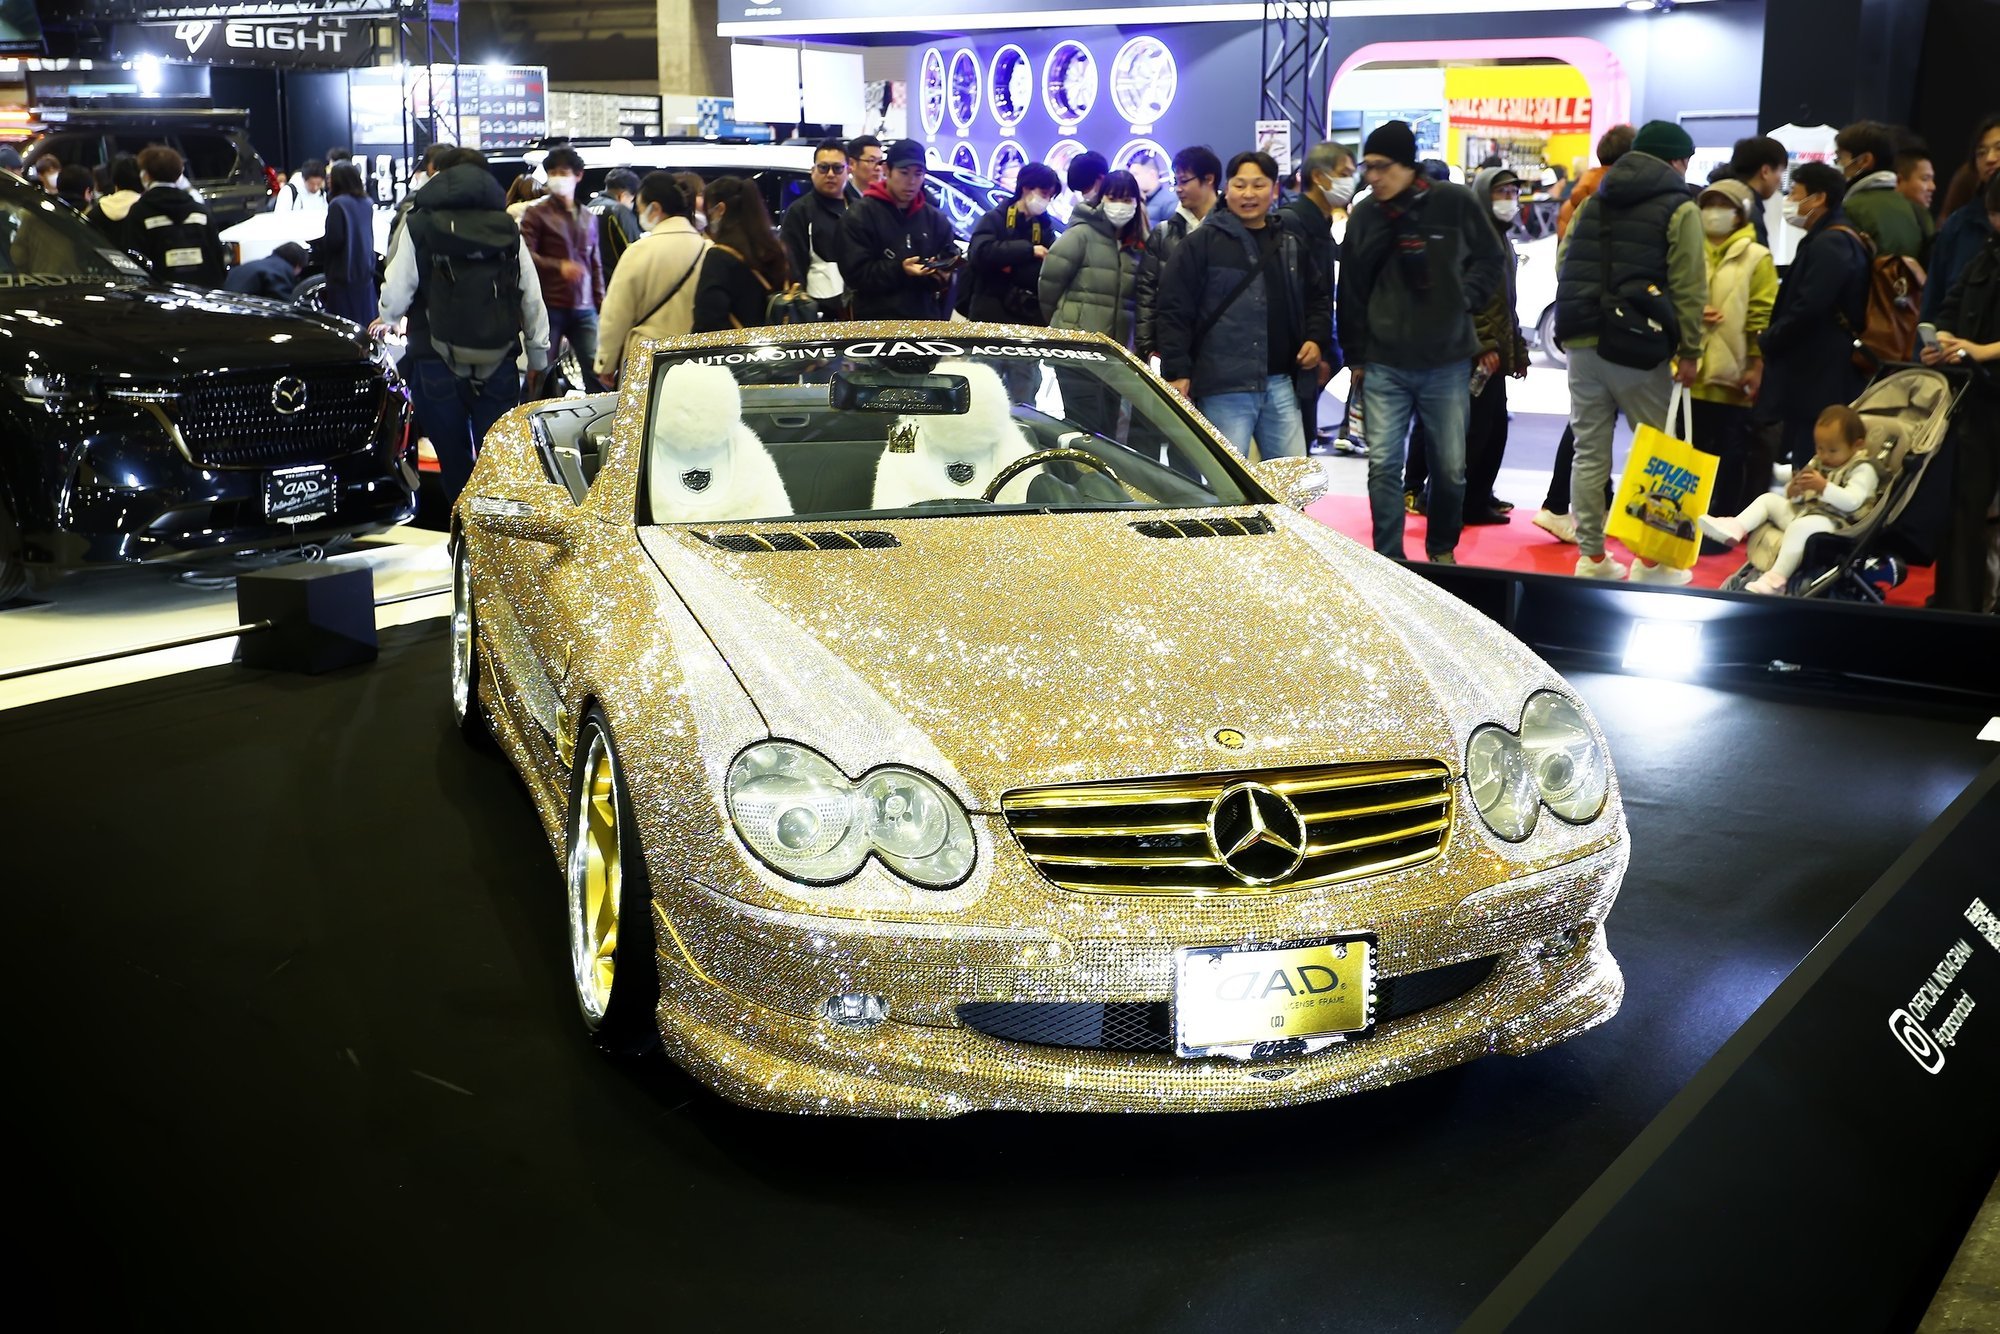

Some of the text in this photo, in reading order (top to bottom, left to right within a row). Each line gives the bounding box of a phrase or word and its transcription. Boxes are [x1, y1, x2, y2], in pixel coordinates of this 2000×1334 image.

[225, 24, 348, 52] EIGHT
[1533, 97, 1591, 124] SALE
[684, 347, 837, 366] AUTOMOTIVE
[971, 345, 1107, 362] ACCESSORIES
[1908, 937, 1974, 1022] OFFICIAL INSTAGRAM
[1319, 996, 1345, 1006] FRAME
